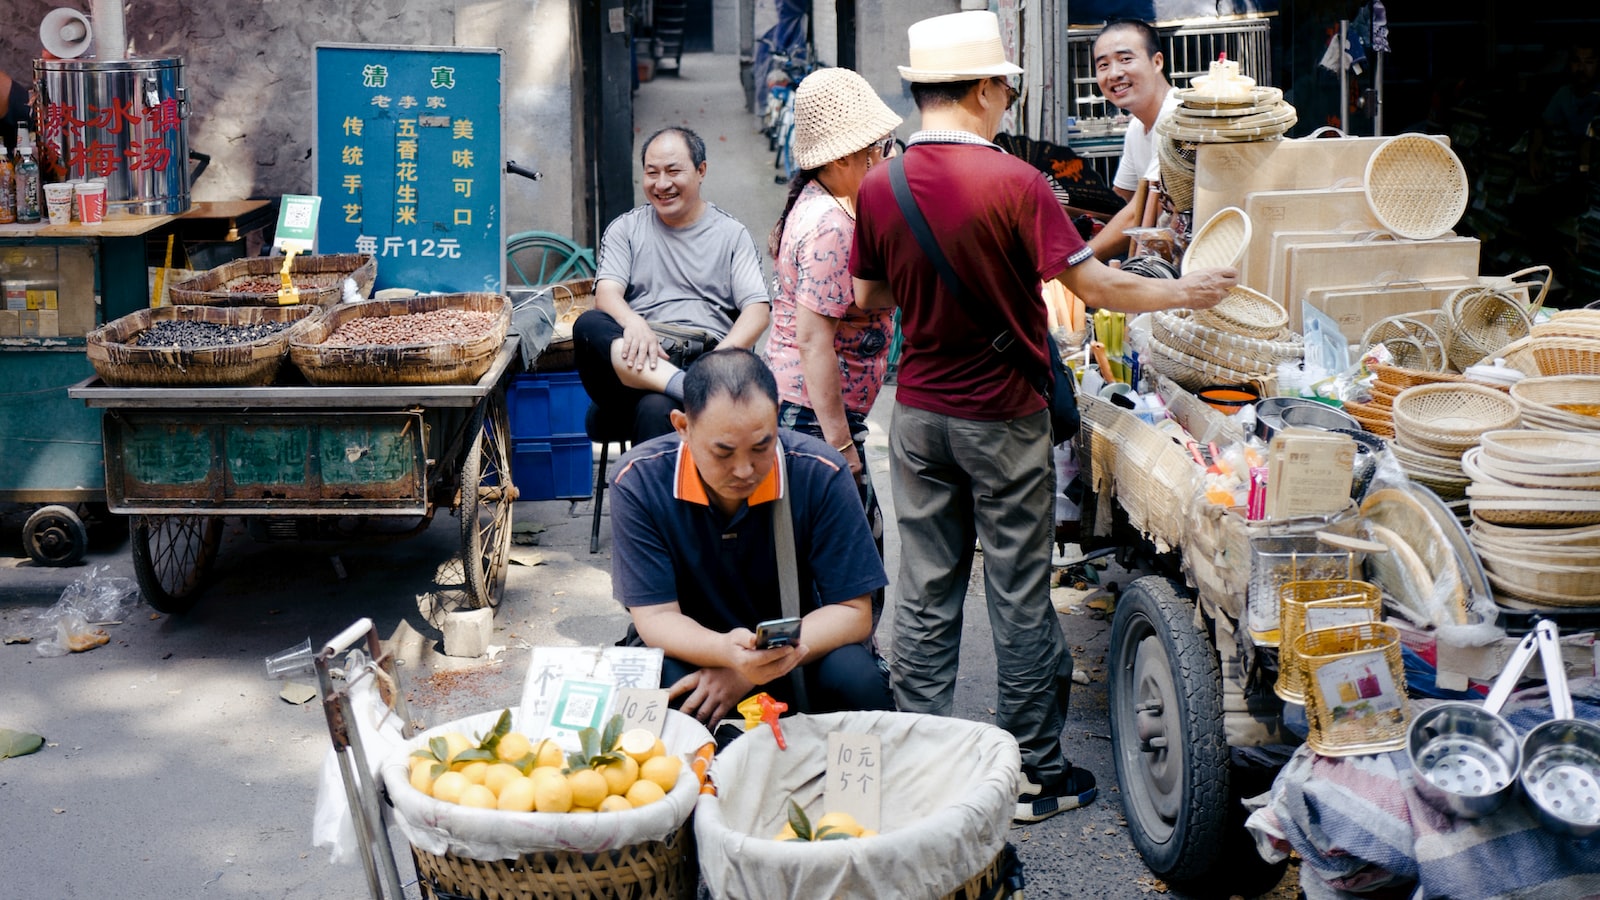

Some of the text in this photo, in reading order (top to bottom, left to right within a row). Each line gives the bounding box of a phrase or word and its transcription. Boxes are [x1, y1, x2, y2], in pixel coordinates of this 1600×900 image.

[363, 64, 455, 89] 清真
[371, 95, 446, 109] 老李家
[342, 116, 364, 224] 传统手艺
[396, 118, 419, 225] 五香花生米
[452, 119, 475, 226] 美味可口
[354, 234, 462, 259] 每斤12元
[621, 695, 658, 724] 10元
[837, 743, 875, 767] 10元
[840, 771, 874, 793] 5个
